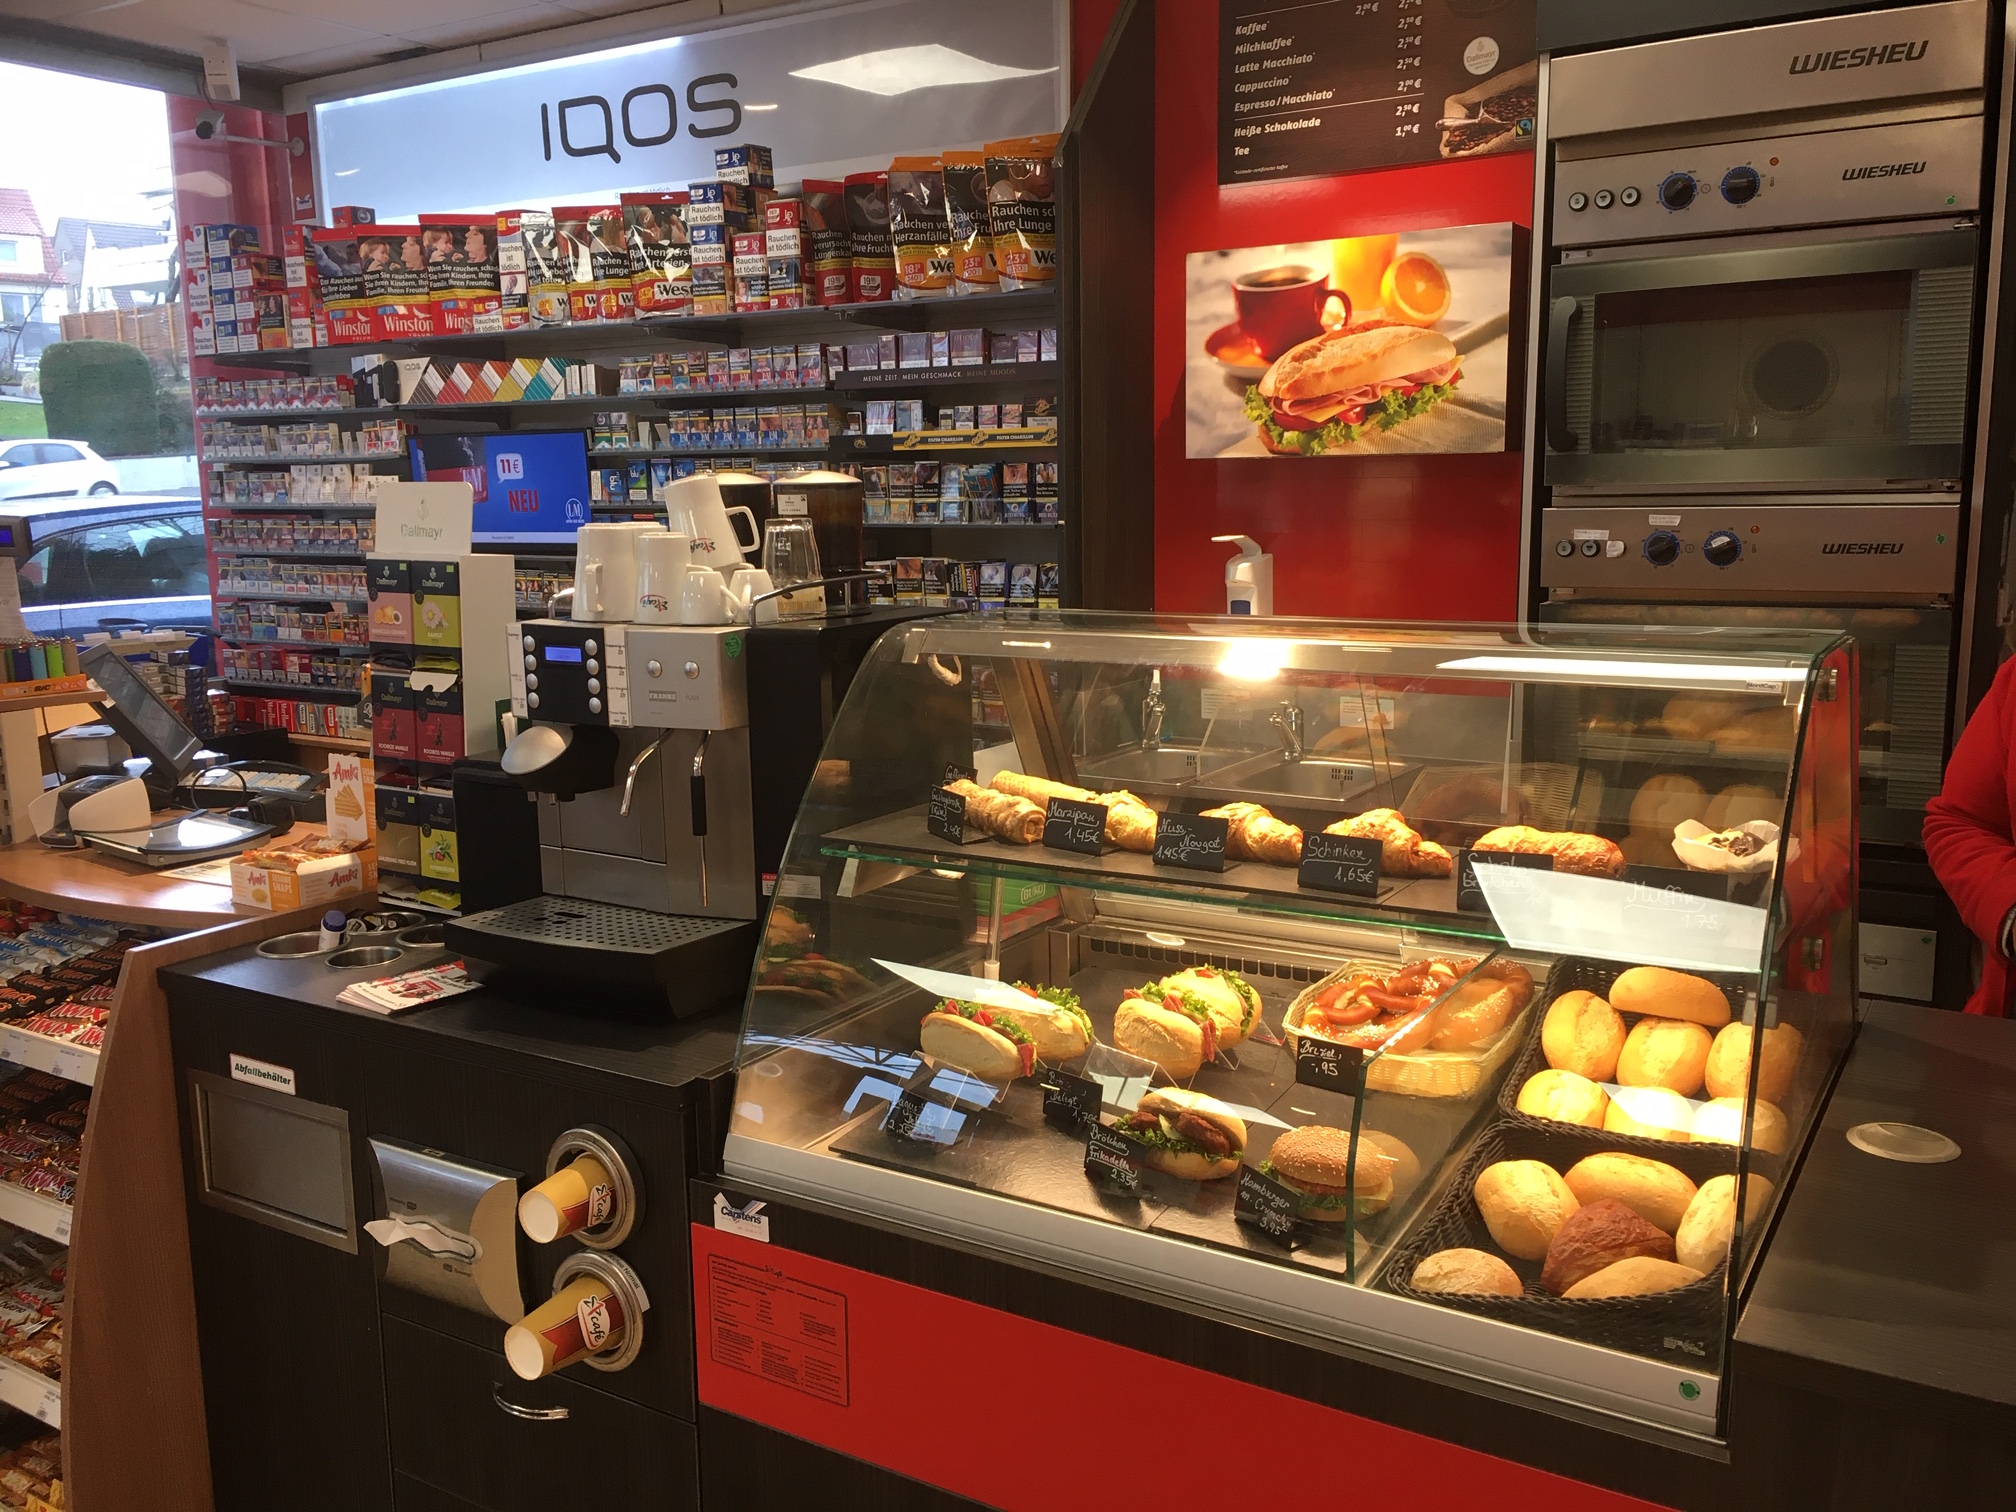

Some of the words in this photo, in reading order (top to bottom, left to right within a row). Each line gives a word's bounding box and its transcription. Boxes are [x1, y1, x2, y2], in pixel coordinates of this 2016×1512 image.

[1235, 20, 1269, 36] Kaffee
[1235, 37, 1293, 55] Milchkaffee
[1235, 61, 1260, 74] Latte
[1262, 53, 1314, 70] Macchiato
[1466, 50, 1496, 63] Dallmayr
[1788, 39, 1929, 75] WIESHEU
[1234, 76, 1290, 94] Cappuccino
[541, 73, 742, 164] IQOS
[1234, 124, 1262, 138] Heiße
[1264, 117, 1321, 133] Schokolade
[1234, 146, 1250, 156] Tee
[717, 169, 745, 178] Rauchen
[1841, 161, 1927, 182] WIESHEU
[691, 205, 720, 213] Rauchen
[951, 208, 989, 223] Rauche
[992, 203, 1040, 219] Rauchen
[699, 213, 723, 221] tödlich
[893, 217, 939, 231] Rauchen
[993, 218, 1016, 233] Ihre
[1017, 217, 1052, 232] Lunge
[767, 234, 797, 242] Rauchen
[811, 230, 843, 240] Rauchen
[852, 232, 884, 242] Rauchen
[895, 230, 949, 244] Herzanfälle
[693, 246, 722, 254] Rauchen
[775, 242, 800, 250] tödlich
[813, 240, 852, 250] verursacht
[852, 243, 866, 252] Ihre
[506, 254, 514, 262] ist
[700, 254, 724, 262] tödlich
[735, 256, 765, 264] Rauchen
[501, 262, 521, 271] tödlich
[605, 267, 629, 276] Lunge
[743, 264, 767, 273] tödlich
[380, 271, 391, 279] Sie
[364, 281, 374, 289] Sie
[465, 279, 494, 287] Freunden
[383, 314, 433, 333] Winston
[474, 317, 499, 325] Rauchen
[481, 324, 502, 333] tödlich
[862, 374, 882, 382] MEINE
[989, 368, 1016, 376] MOODS
[630, 470, 639, 478] blu
[676, 468, 686, 477] blu
[508, 489, 539, 512] NEU
[400, 524, 444, 541] Dallmayr
[1821, 542, 1904, 556] WIESHEU
[376, 577, 398, 587] Dallmayr
[421, 579, 445, 588] Dallmayr
[440, 749, 456, 757] VANILLE
[1047, 801, 1095, 825] Marzipan
[1064, 827, 1100, 844] 1,45€
[1179, 834, 1221, 854] Nougat
[1307, 835, 1366, 860] Schinken
[271, 873, 292, 885] SESAME
[1334, 866, 1375, 884] 1,65€
[273, 881, 293, 894] SNAPS
[234, 1062, 292, 1085] Abfallbehälter
[1090, 1123, 1128, 1152] Brötchen
[1089, 1145, 1133, 1174] Frikadelle
[1110, 1168, 1138, 1190] 2,35€
[1240, 1172, 1290, 1209] Hamburger
[720, 1206, 762, 1225] Carstens
[1254, 1197, 1292, 1227] Crunchy
[624, 1267, 641, 1290] Normal
